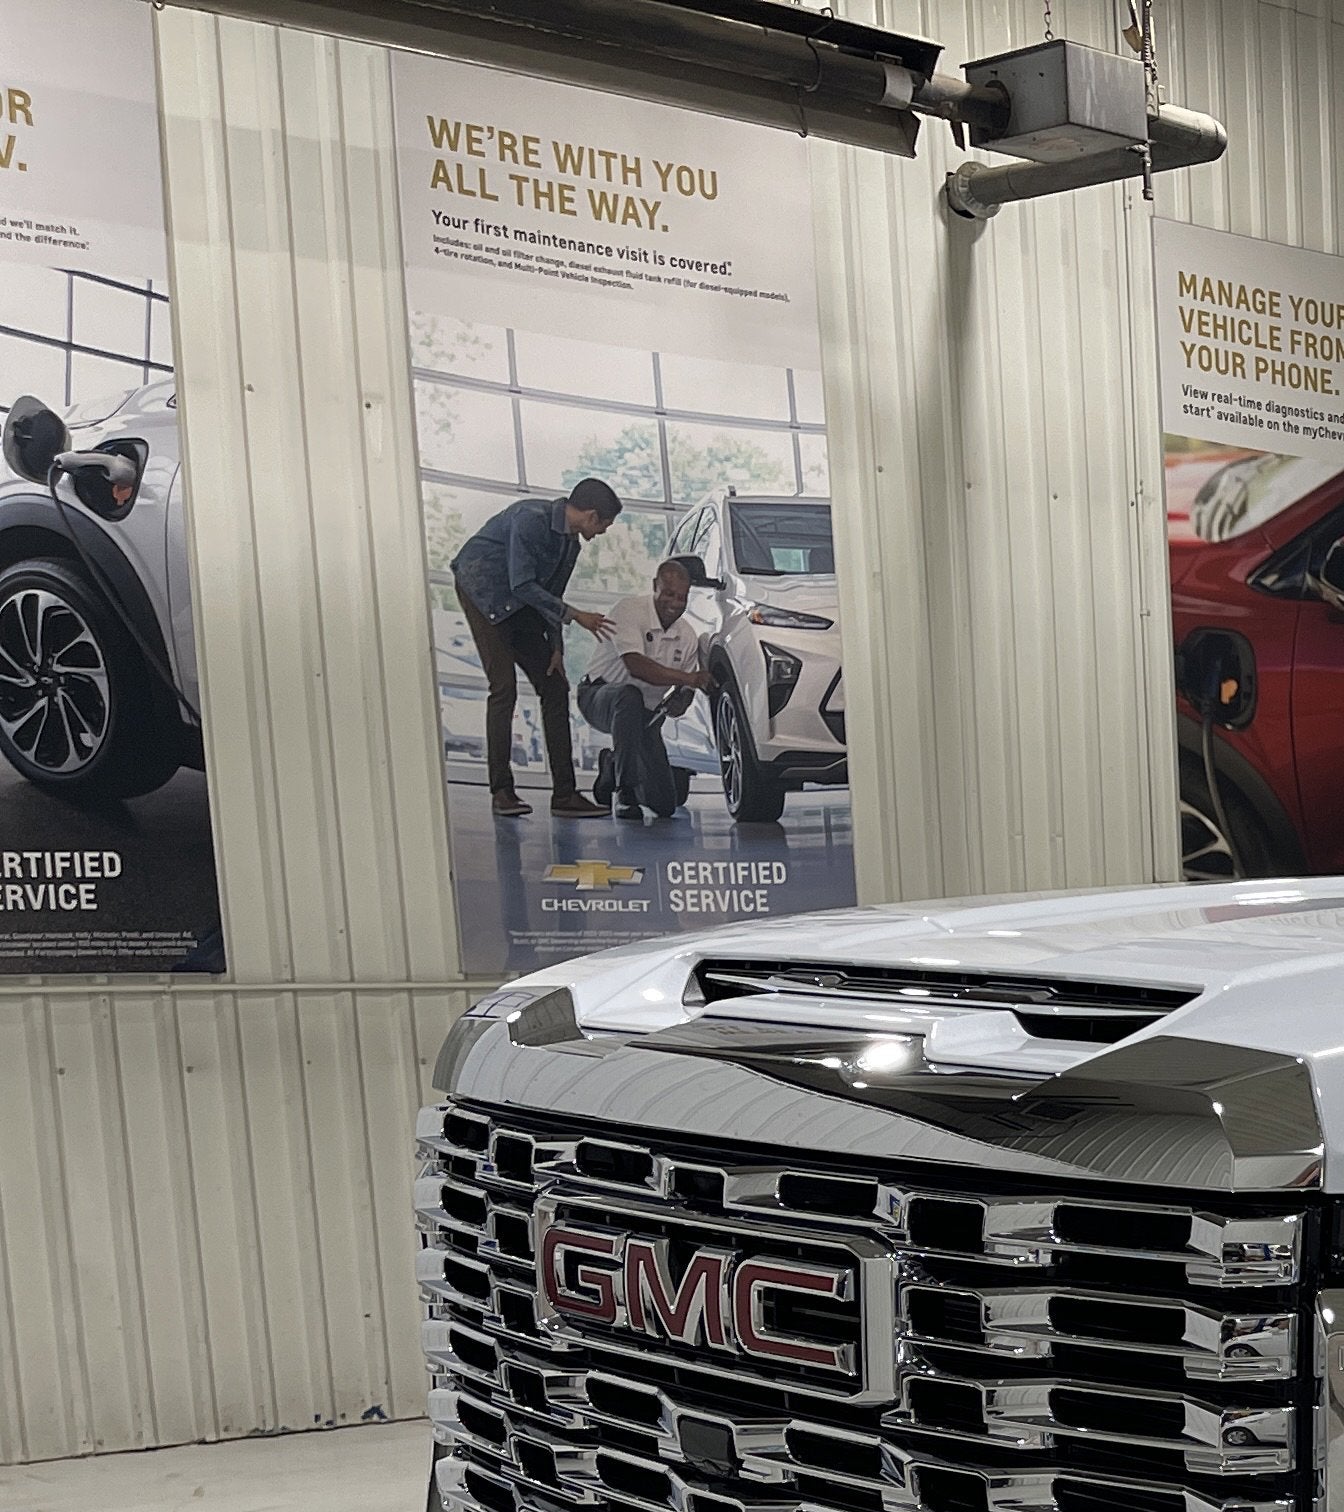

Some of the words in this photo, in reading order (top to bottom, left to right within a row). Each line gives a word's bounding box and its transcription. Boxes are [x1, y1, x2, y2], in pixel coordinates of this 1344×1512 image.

[0, 88, 34, 126] R
[426, 115, 542, 169] WE'RE
[551, 140, 643, 188] WITH
[652, 160, 718, 200] YOU
[430, 159, 499, 202] ALL
[509, 174, 577, 217] THE
[587, 188, 669, 232] WAY.
[15, 232, 32, 242] the
[35, 223, 67, 234] match
[432, 209, 469, 231] Your
[473, 217, 510, 239] first
[513, 229, 614, 257] maintenance
[616, 245, 649, 264] visit
[653, 250, 666, 266] is
[1178, 270, 1282, 319] MANAGE
[1178, 305, 1282, 352] VEHICLE
[1179, 340, 1247, 379] YOUR
[1255, 356, 1340, 396] PHONE.
[1181, 383, 1208, 400] View
[1211, 391, 1262, 411] real-time
[1265, 400, 1325, 421] diagnostics
[1216, 410, 1264, 428] available
[1266, 420, 1280, 431] on
[1282, 421, 1300, 434] the
[0, 850, 123, 878] RTIFIED
[666, 861, 787, 885] CERTIFIED
[0, 883, 98, 911] RVICE
[541, 898, 652, 912] CHEVROLET
[668, 889, 770, 913] SERVICE
[543, 1223, 855, 1374] GMC
